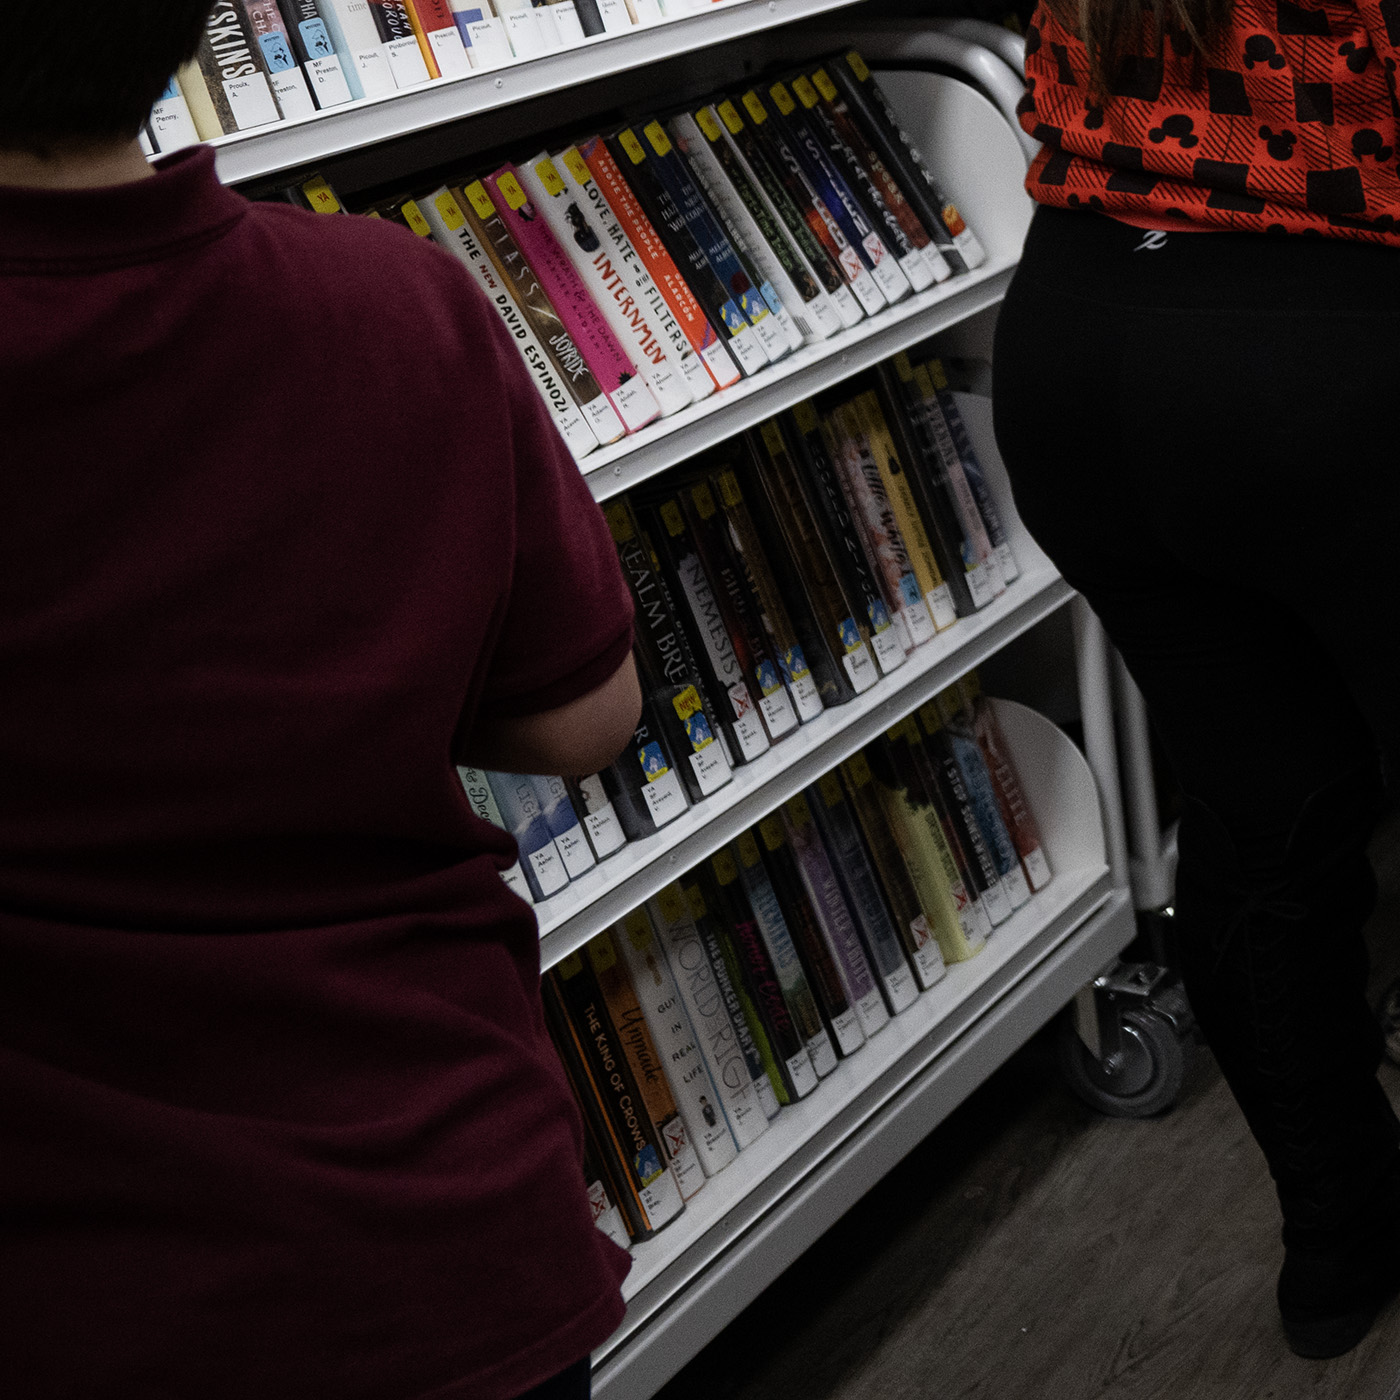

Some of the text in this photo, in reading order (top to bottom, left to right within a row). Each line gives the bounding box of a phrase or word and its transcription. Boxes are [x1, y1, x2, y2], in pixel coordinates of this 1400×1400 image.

[229, 82, 250, 91] Proulx,
[582, 178, 637, 264] LOVE, HATE
[597, 159, 660, 261] ABOVE THE PEOPLE
[458, 228, 528, 340] THE NEW DAVID
[591, 250, 668, 366] INTERNMEN
[674, 272, 700, 313] DANIEL
[643, 287, 688, 357] FILTERS
[548, 331, 590, 383] JOYRIDE
[686, 563, 739, 676] NEMESIS
[679, 691, 695, 711] NEW
[656, 996, 677, 1014] GUY
[670, 1021, 683, 1035] IN
[620, 1007, 659, 1083] Unmade
[671, 1042, 698, 1062] REAL
[682, 1065, 705, 1085] LIFE
[584, 1002, 647, 1151] THE KING OF CROWS
